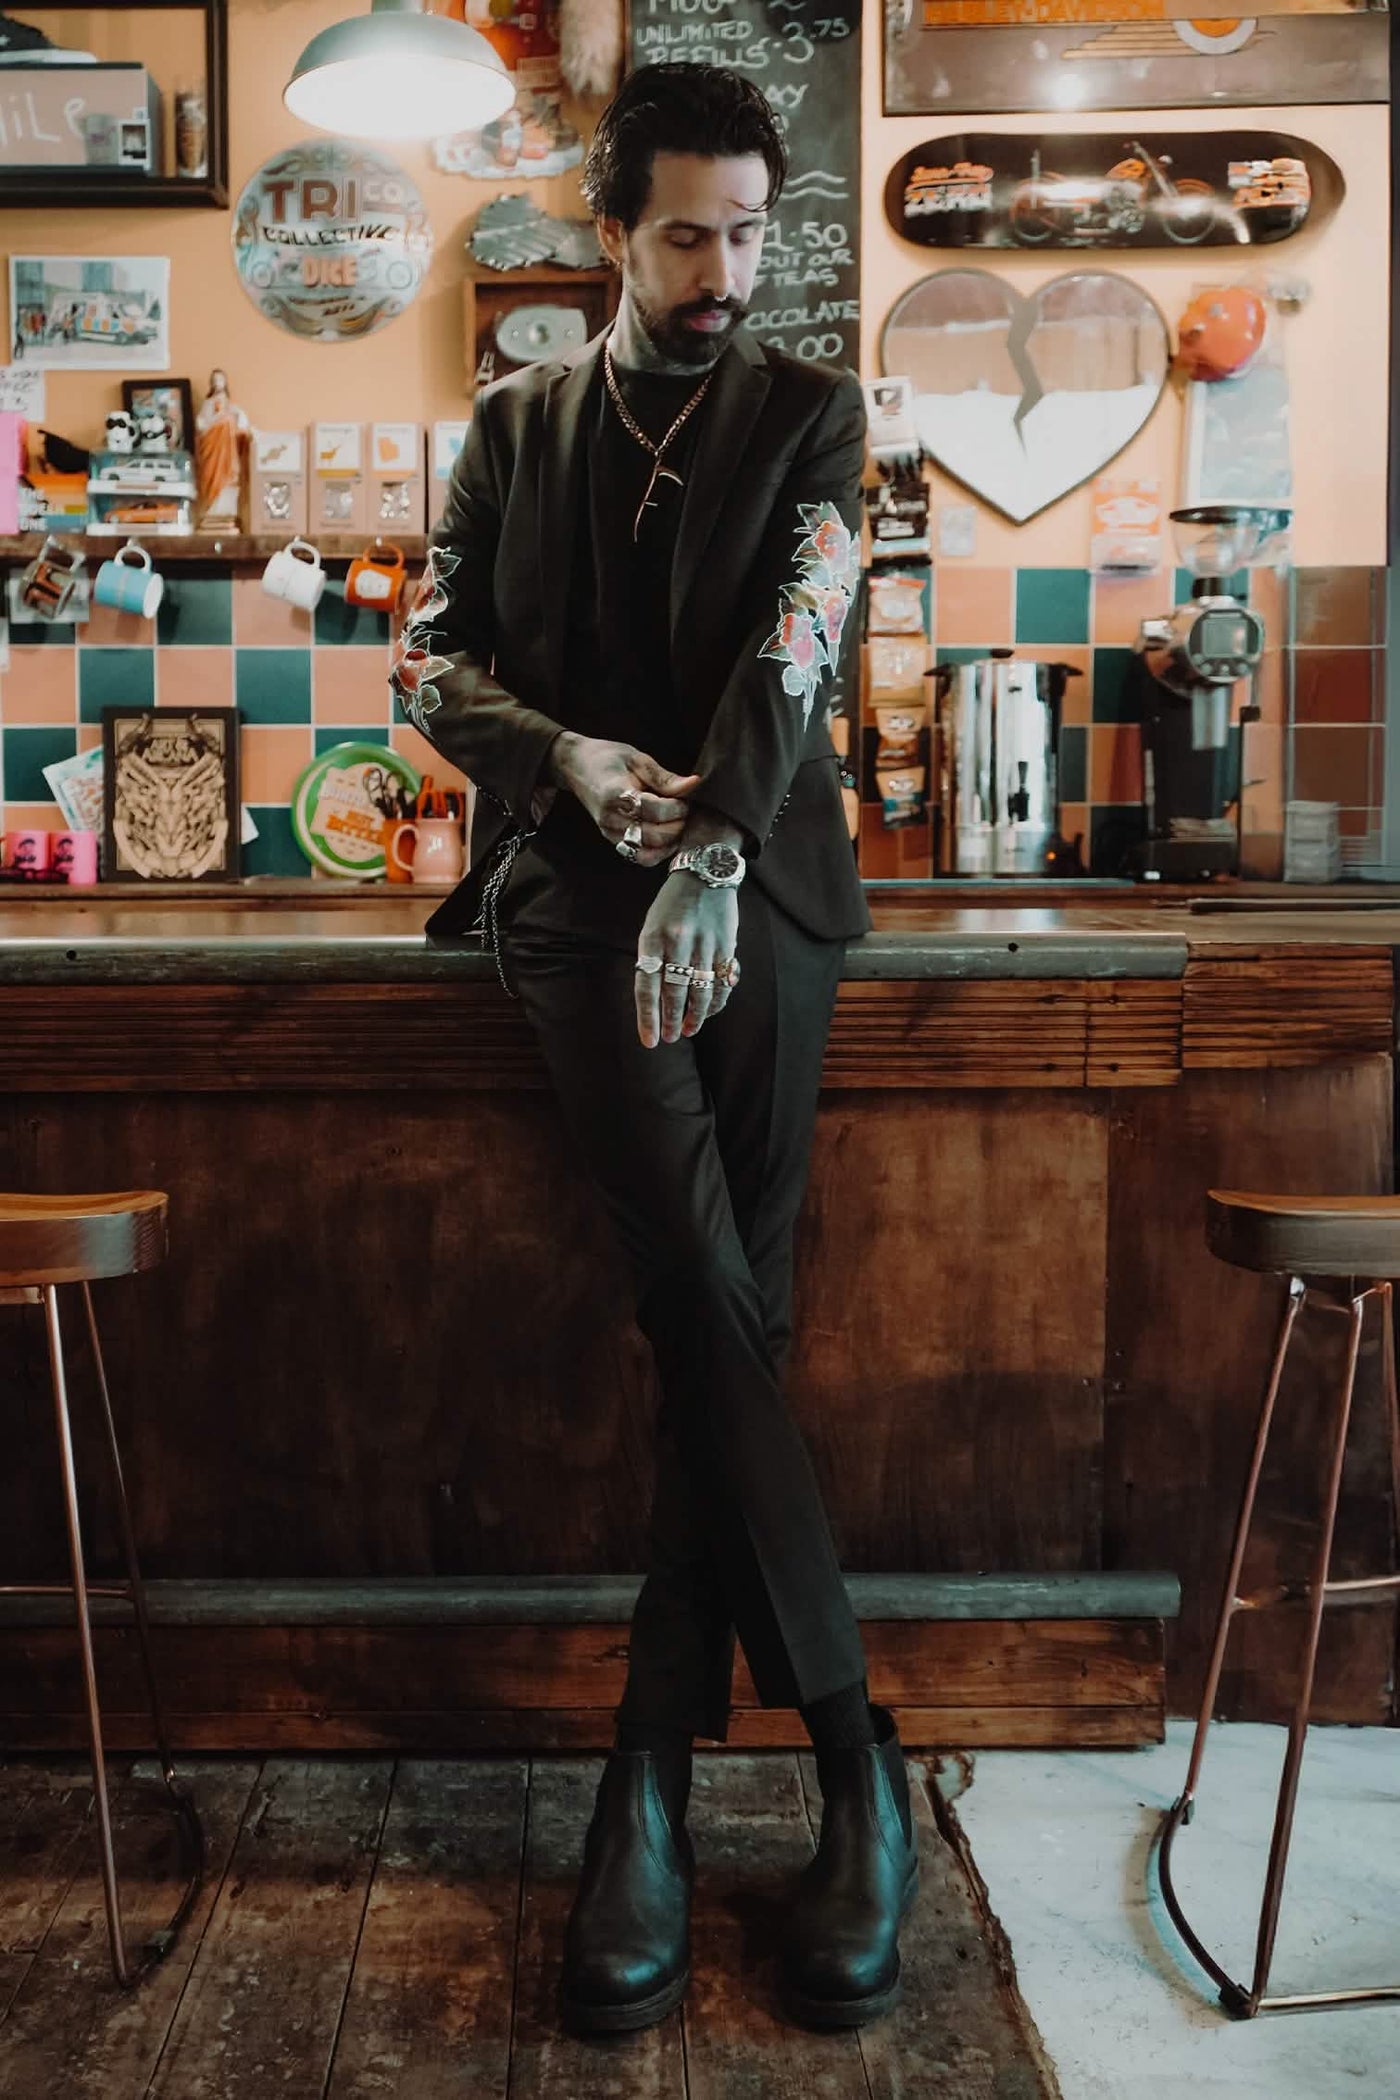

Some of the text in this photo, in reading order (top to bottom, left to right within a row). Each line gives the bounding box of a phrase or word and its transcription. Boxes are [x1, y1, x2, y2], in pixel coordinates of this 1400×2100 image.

[636, 20, 753, 46] UNLIMITED
[645, 37, 770, 69] REFILLS
[807, 248, 854, 266] OUR
[772, 267, 839, 287] TEAS
[744, 300, 860, 331] OCOLATE
